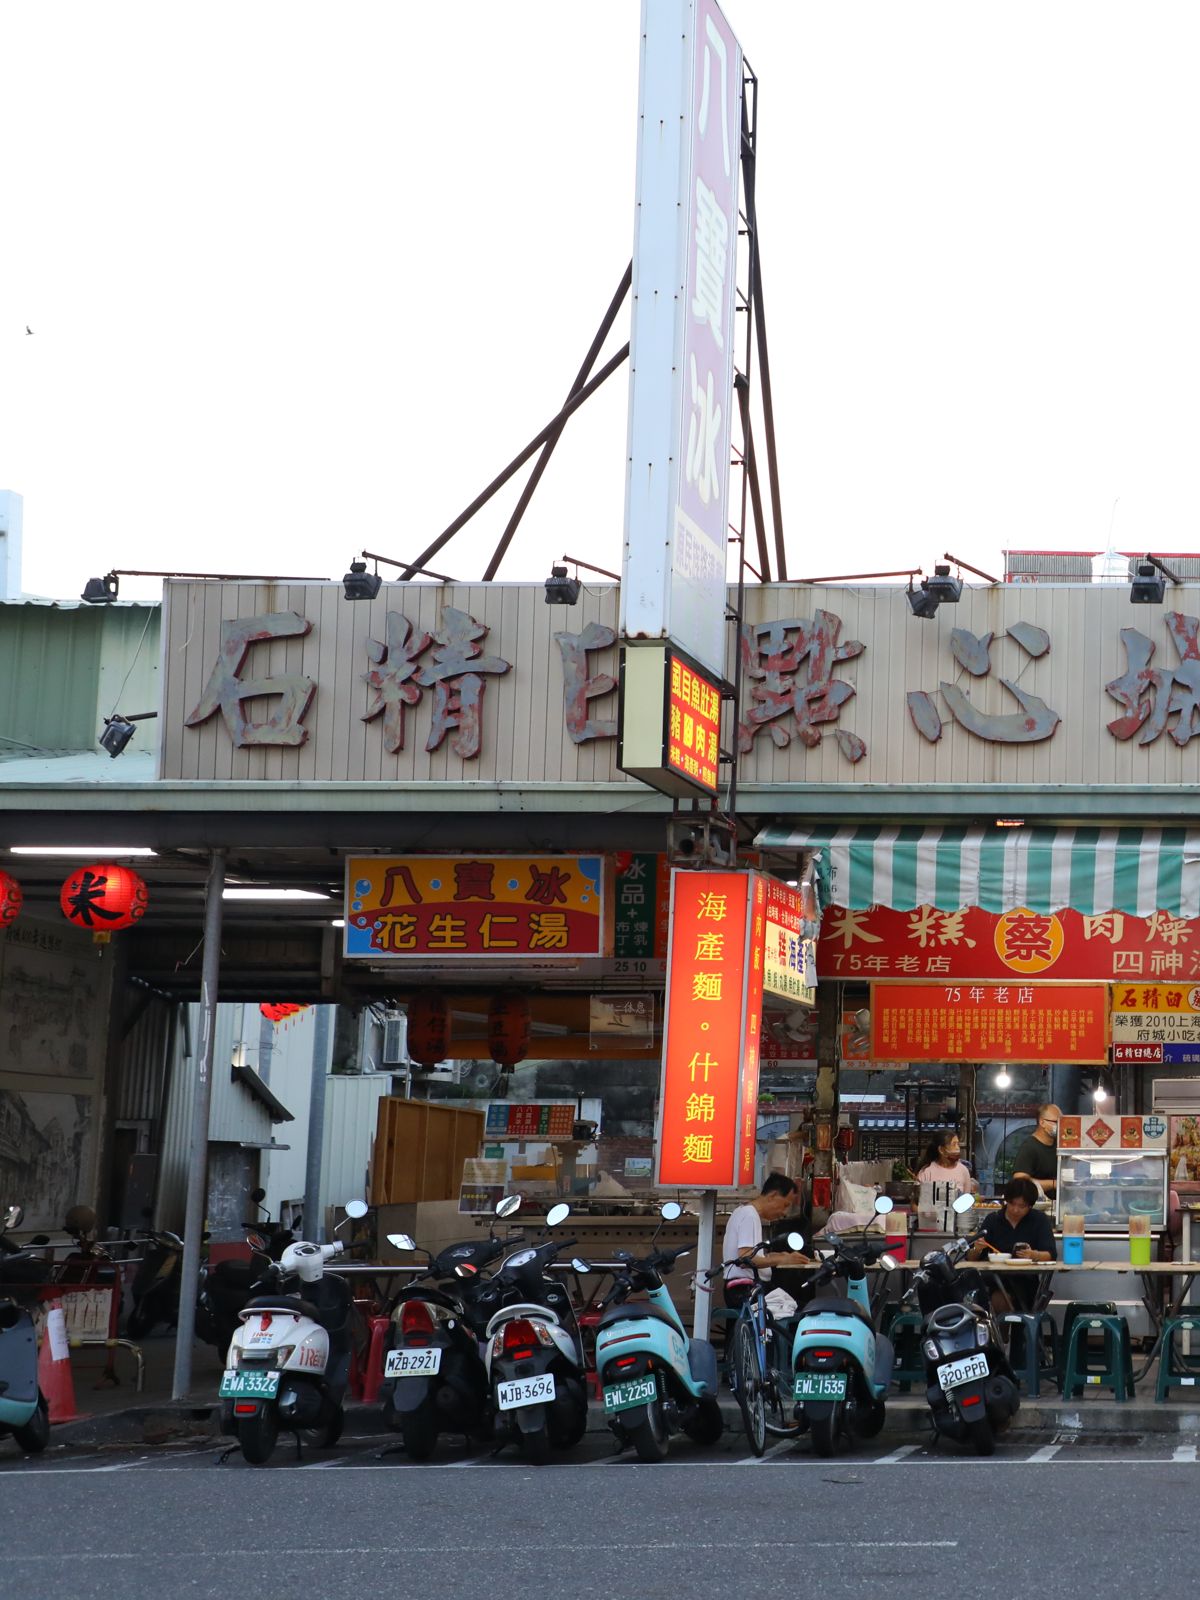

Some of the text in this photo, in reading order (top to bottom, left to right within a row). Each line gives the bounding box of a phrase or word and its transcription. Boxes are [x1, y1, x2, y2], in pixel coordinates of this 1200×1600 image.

[686, 13, 731, 506] 八寶冰
[380, 861, 571, 907] 八寶冰
[377, 913, 569, 949] 花生仁湯
[825, 903, 976, 948] 米糕
[1004, 914, 1054, 962] 蔡
[615, 961, 629, 972] 25
[634, 961, 647, 972] 10
[832, 953, 951, 973] 75年老店
[945, 987, 1034, 1004] 75年老店
